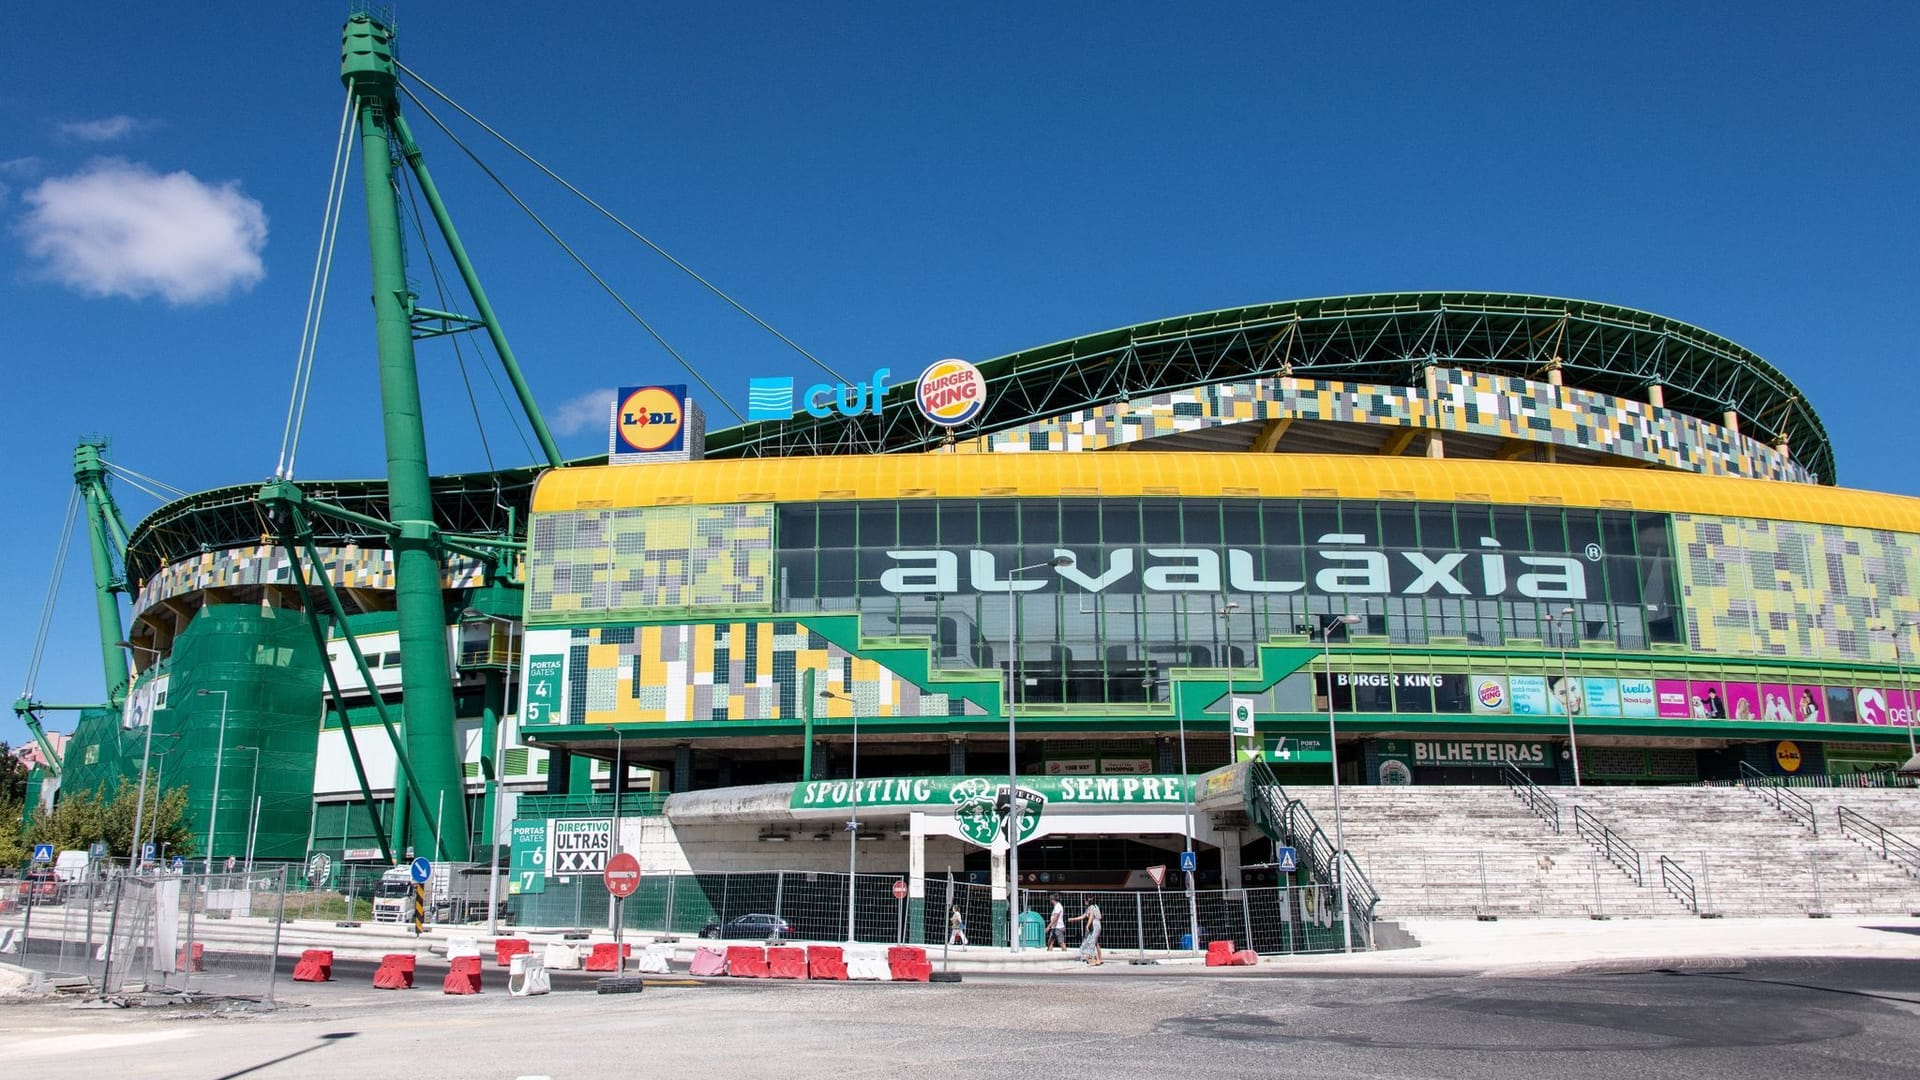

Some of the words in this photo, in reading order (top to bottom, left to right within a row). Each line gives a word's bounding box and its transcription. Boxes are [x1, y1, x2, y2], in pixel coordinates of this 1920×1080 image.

[923, 370, 974, 396] BURGER
[804, 368, 891, 419] cuf
[926, 382, 977, 412] KING
[531, 661, 561, 669] PORTAS
[531, 669, 555, 677] GATES
[535, 680, 547, 697] 4
[1337, 674, 1399, 687] BURGER
[1404, 674, 1443, 687] KING
[1481, 690, 1501, 702] KING
[528, 702, 539, 720] 5
[1274, 736, 1291, 760] 4
[1414, 742, 1544, 762] BILHETEIRAS
[803, 778, 931, 805] SPORTING
[1061, 777, 1181, 801] SEMPRE
[513, 827, 545, 835] PORTAS
[558, 822, 609, 832] DIRECTIVO
[520, 835, 544, 843] GATES
[557, 833, 609, 849] ULTRAS
[145, 846, 154, 858] P
[532, 846, 544, 865] 6
[559, 852, 606, 871] XXI
[523, 871, 535, 890] 7
